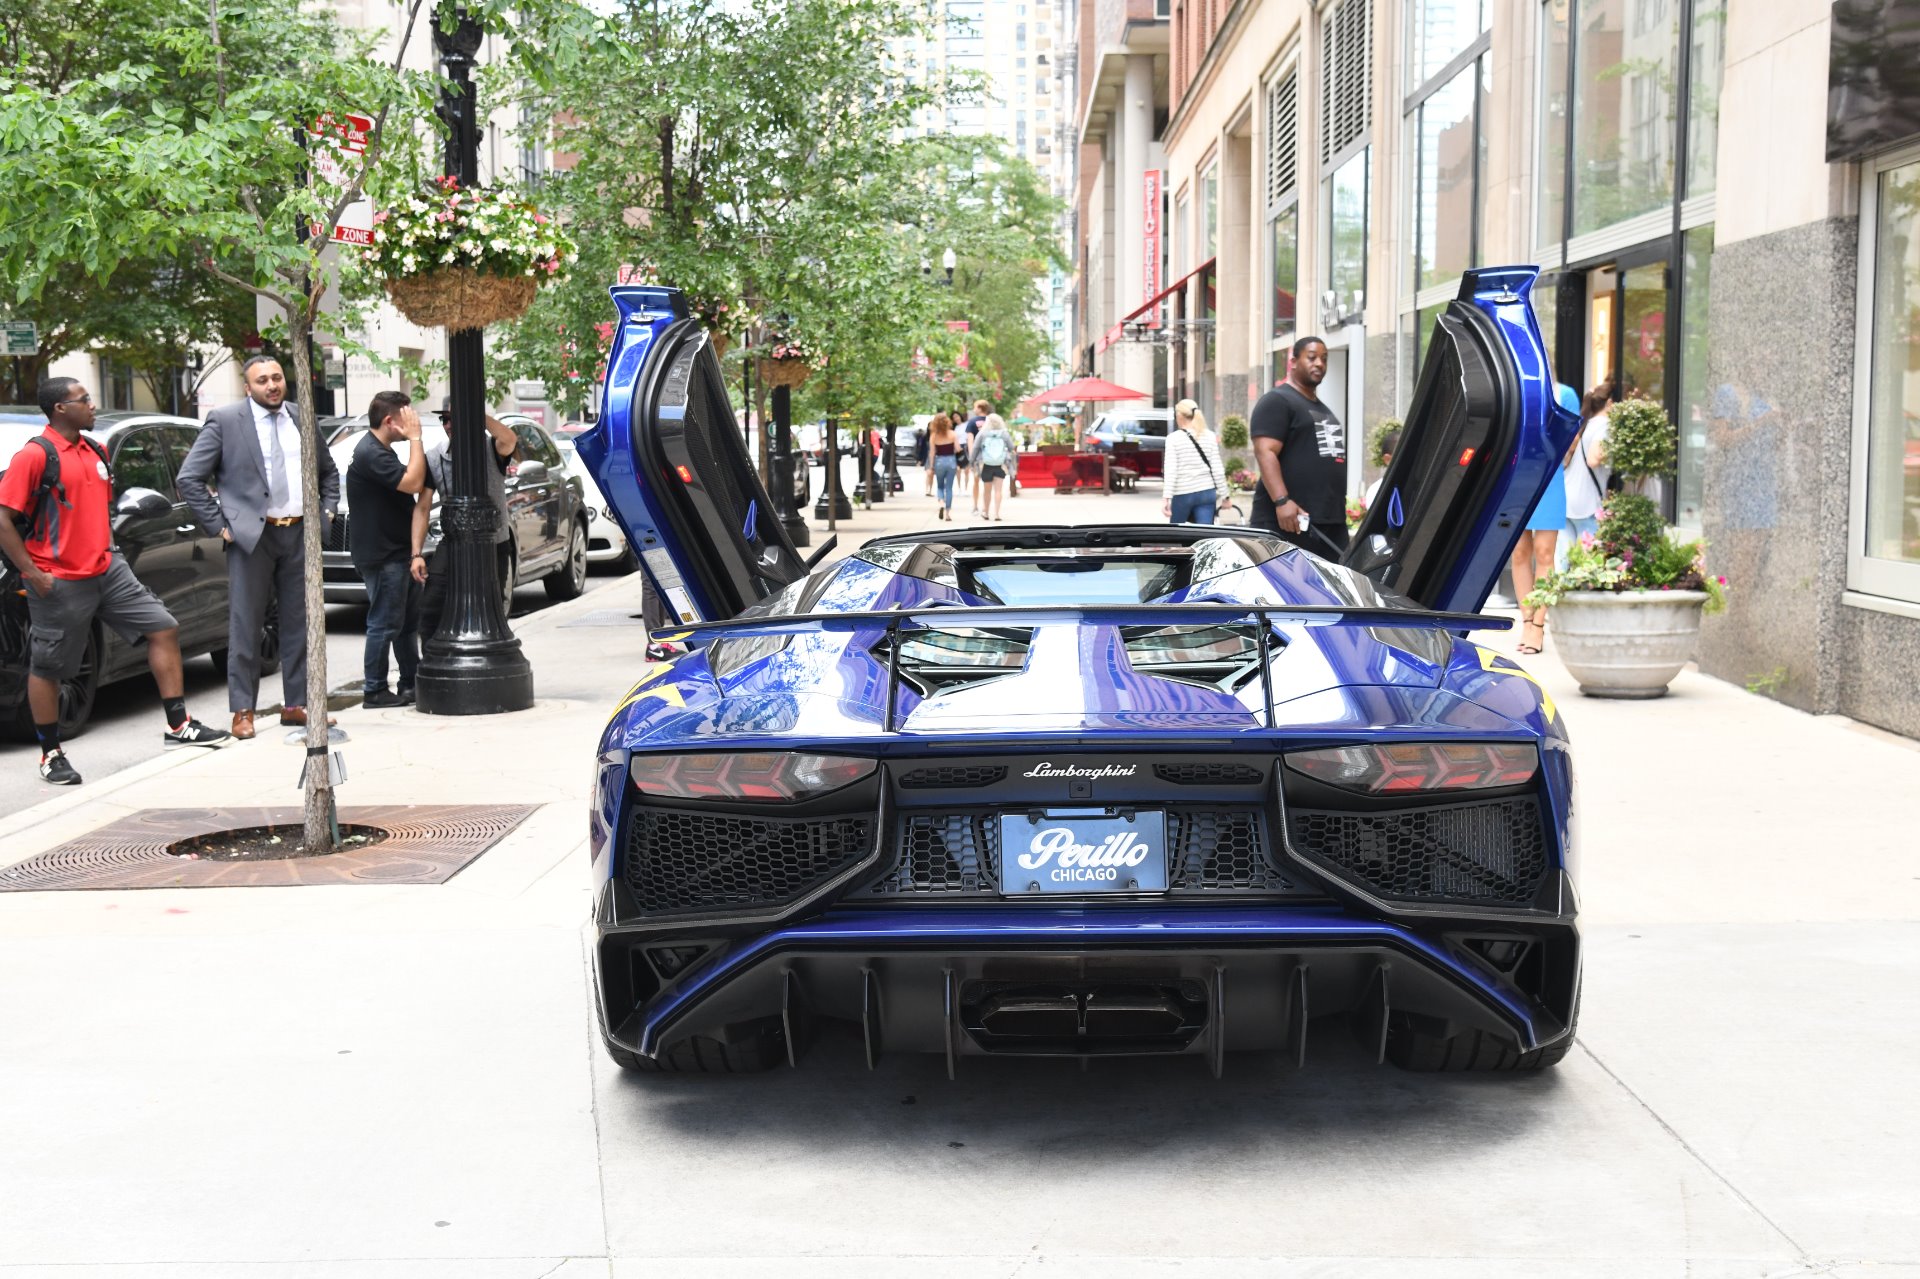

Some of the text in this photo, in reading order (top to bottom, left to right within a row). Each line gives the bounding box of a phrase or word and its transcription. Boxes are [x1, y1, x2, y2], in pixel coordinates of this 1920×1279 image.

[347, 130, 366, 143] ZONE
[1144, 176, 1155, 234] EPIC
[342, 227, 370, 244] ZONE
[1023, 761, 1137, 780] Lamborghini
[1017, 827, 1149, 870] Perillo
[1050, 867, 1118, 882] CHICAGO
